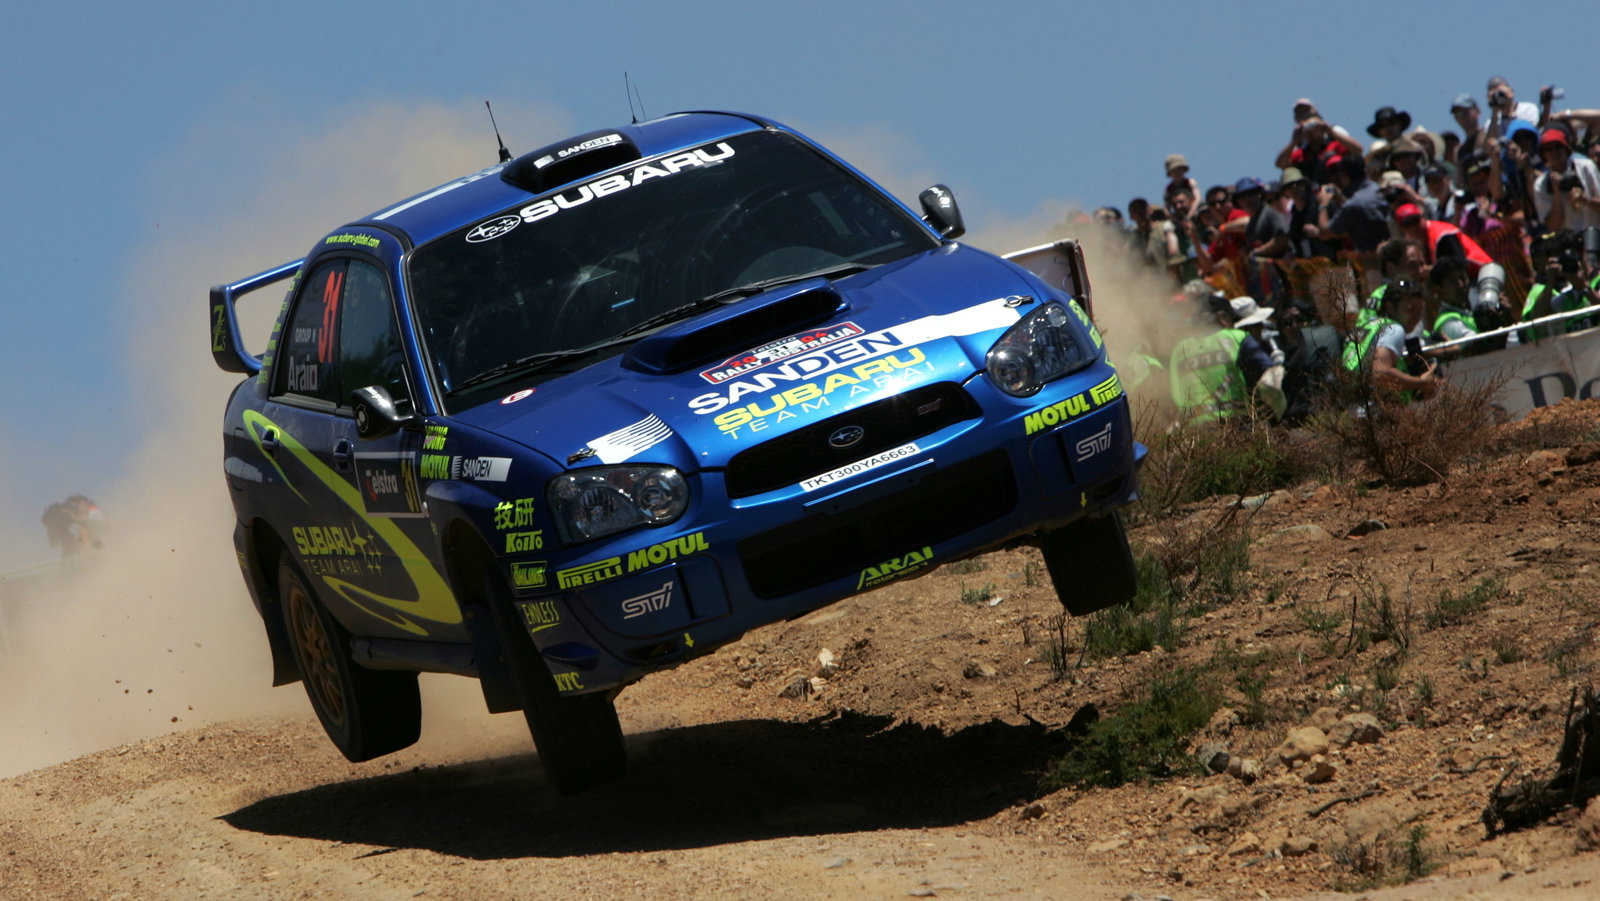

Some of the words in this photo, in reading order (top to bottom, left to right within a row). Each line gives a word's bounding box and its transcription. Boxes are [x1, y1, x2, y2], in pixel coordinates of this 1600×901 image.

[558, 136, 611, 158] SANDEN
[519, 142, 735, 224] SUBARU
[295, 327, 312, 344] GROUP
[768, 345, 788, 355] 31
[712, 358, 765, 381] RALLY
[769, 327, 857, 362] AUSTRALIA
[288, 353, 310, 392] Arai
[688, 331, 904, 415] SANDEN
[713, 348, 926, 432] SUBARU
[722, 396, 831, 440] TEAM
[850, 361, 935, 398] ARAI
[1024, 393, 1091, 436] MOTUL
[421, 454, 450, 480] MOTUL
[462, 459, 492, 477] SANDEN
[803, 445, 917, 490] TKT300YA6663
[494, 498, 535, 531] 技研
[292, 526, 356, 555] SUBARU
[303, 559, 338, 574] TEAM
[556, 556, 623, 590] PIRELLI
[628, 532, 710, 573] MOTUL
[856, 545, 934, 590] ARAI
[522, 601, 560, 625] ENDLESS
[553, 672, 584, 691] KTC
